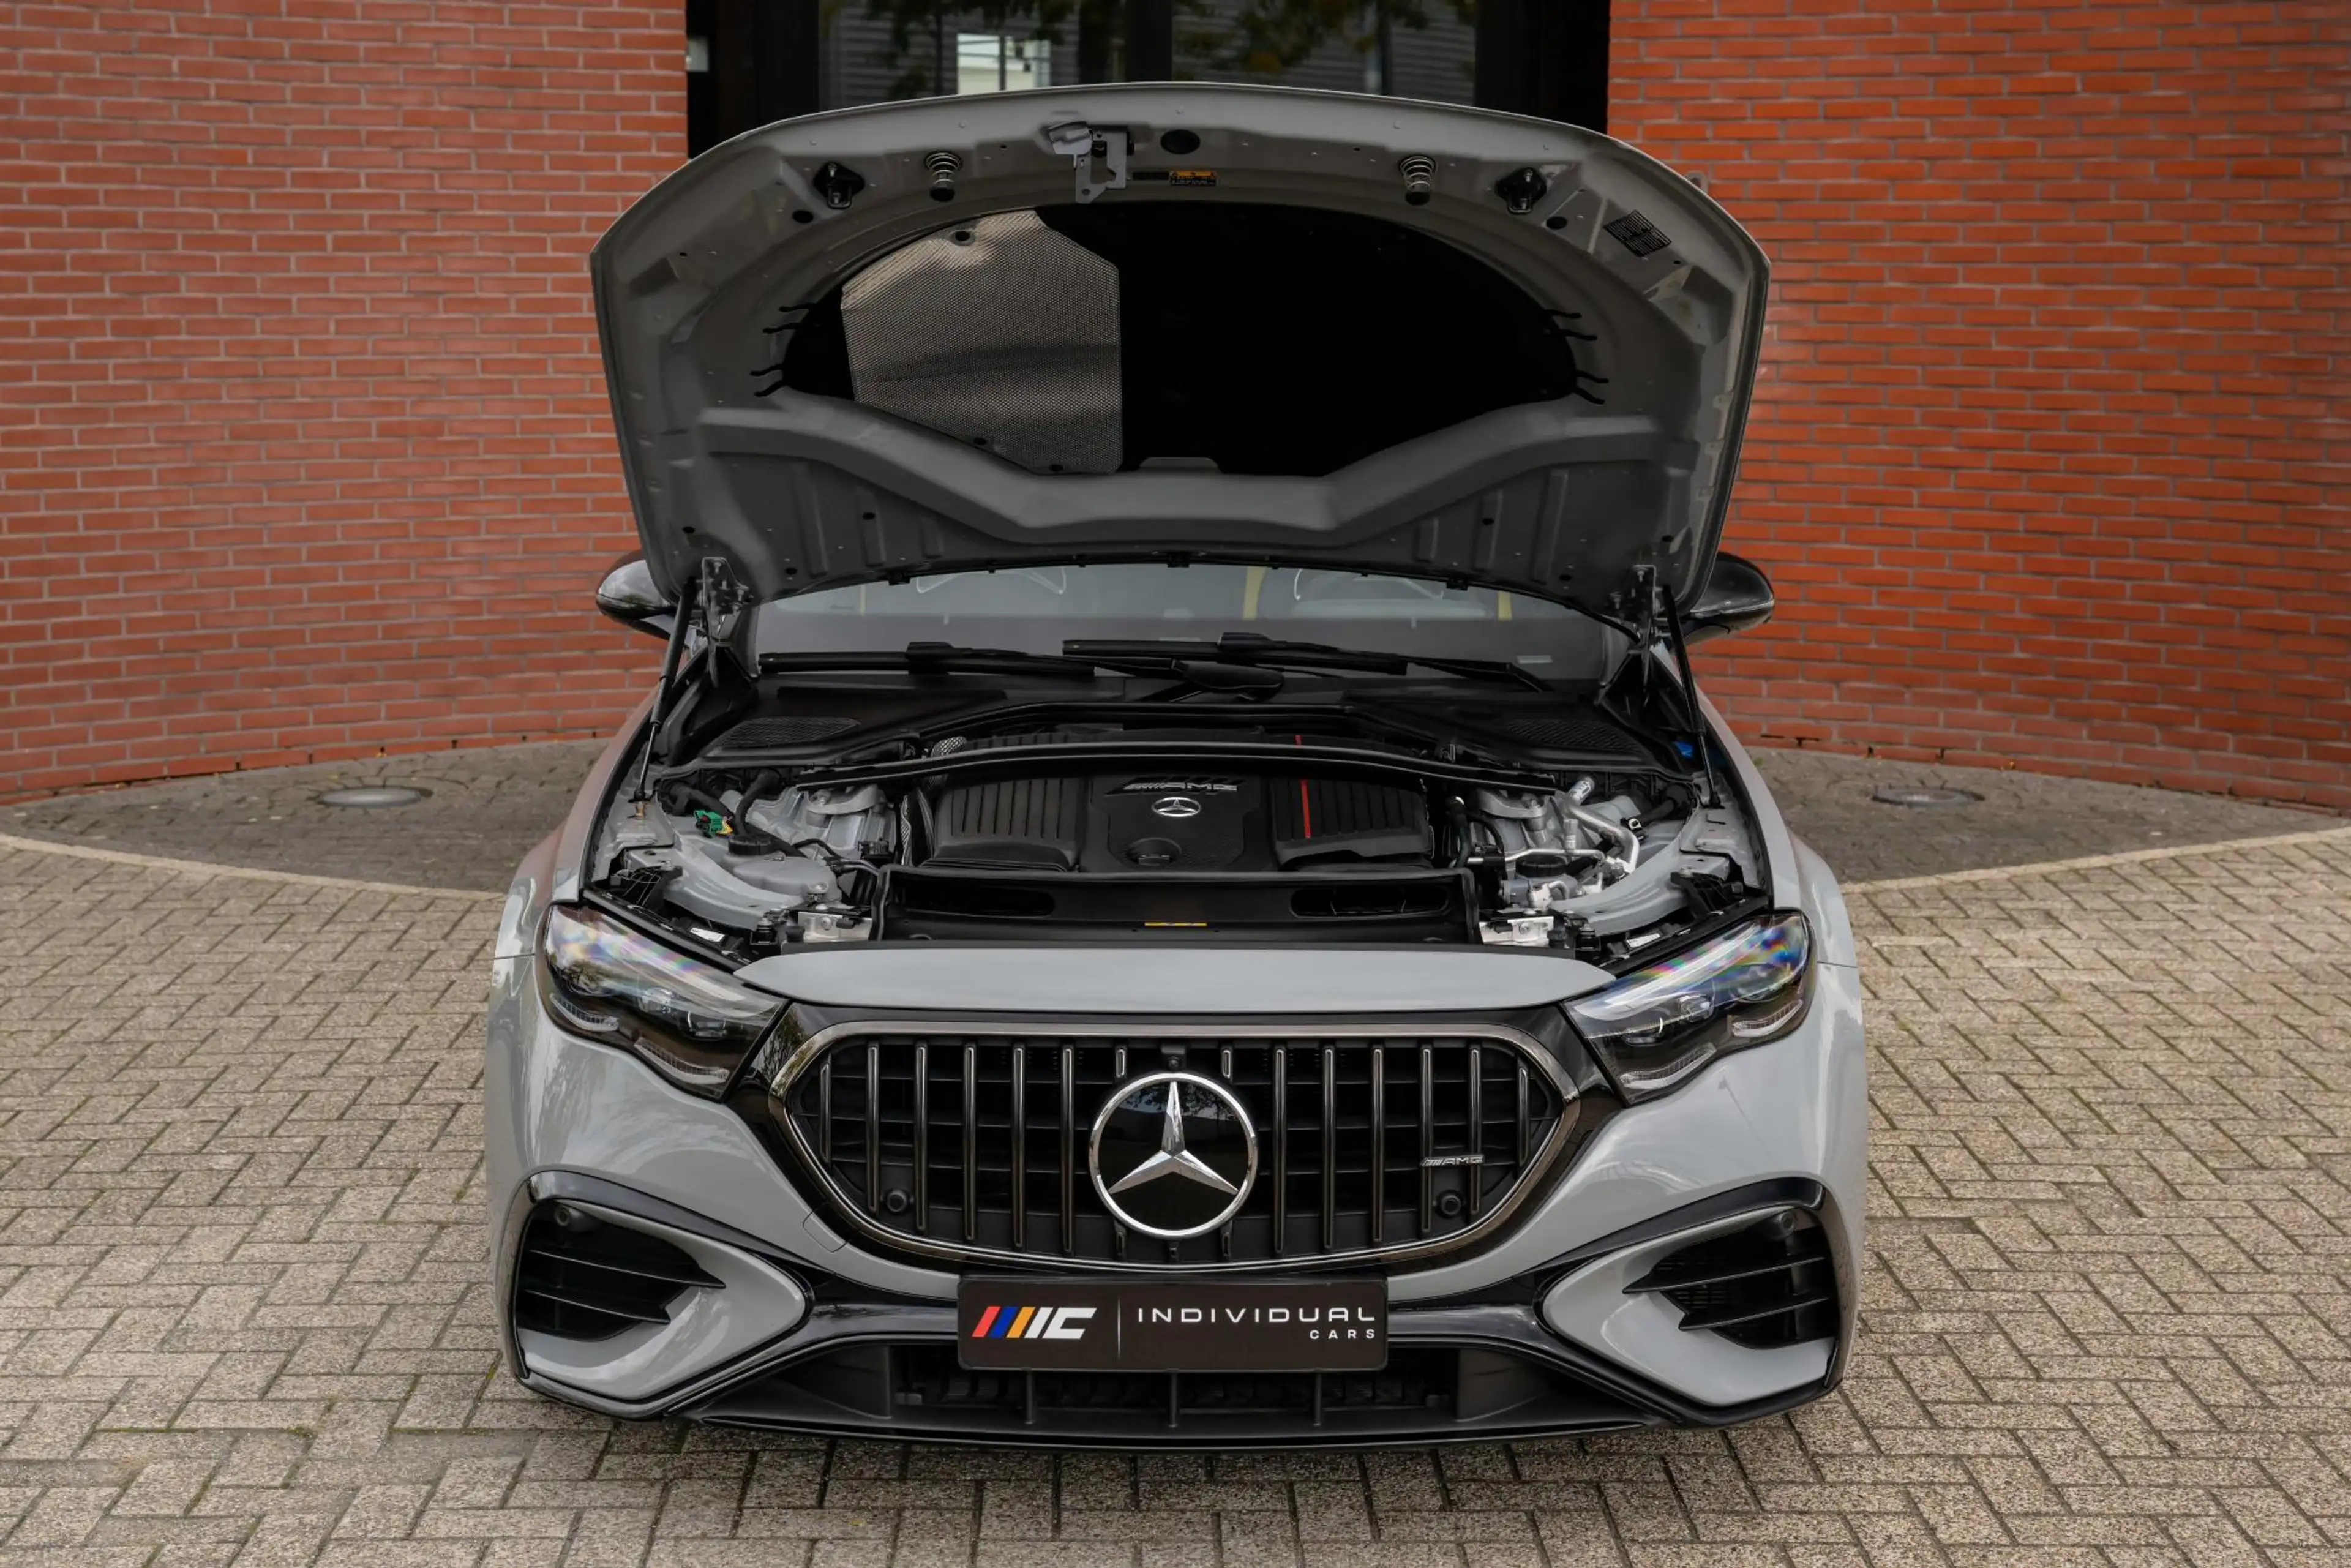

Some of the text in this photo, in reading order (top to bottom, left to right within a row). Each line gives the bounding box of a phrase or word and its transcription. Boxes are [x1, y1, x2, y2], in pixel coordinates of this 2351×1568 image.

[1441, 1155, 1483, 1165] AMG
[1138, 1307, 1375, 1323] INDIVIDUAL
[1310, 1329, 1375, 1340] CARS
